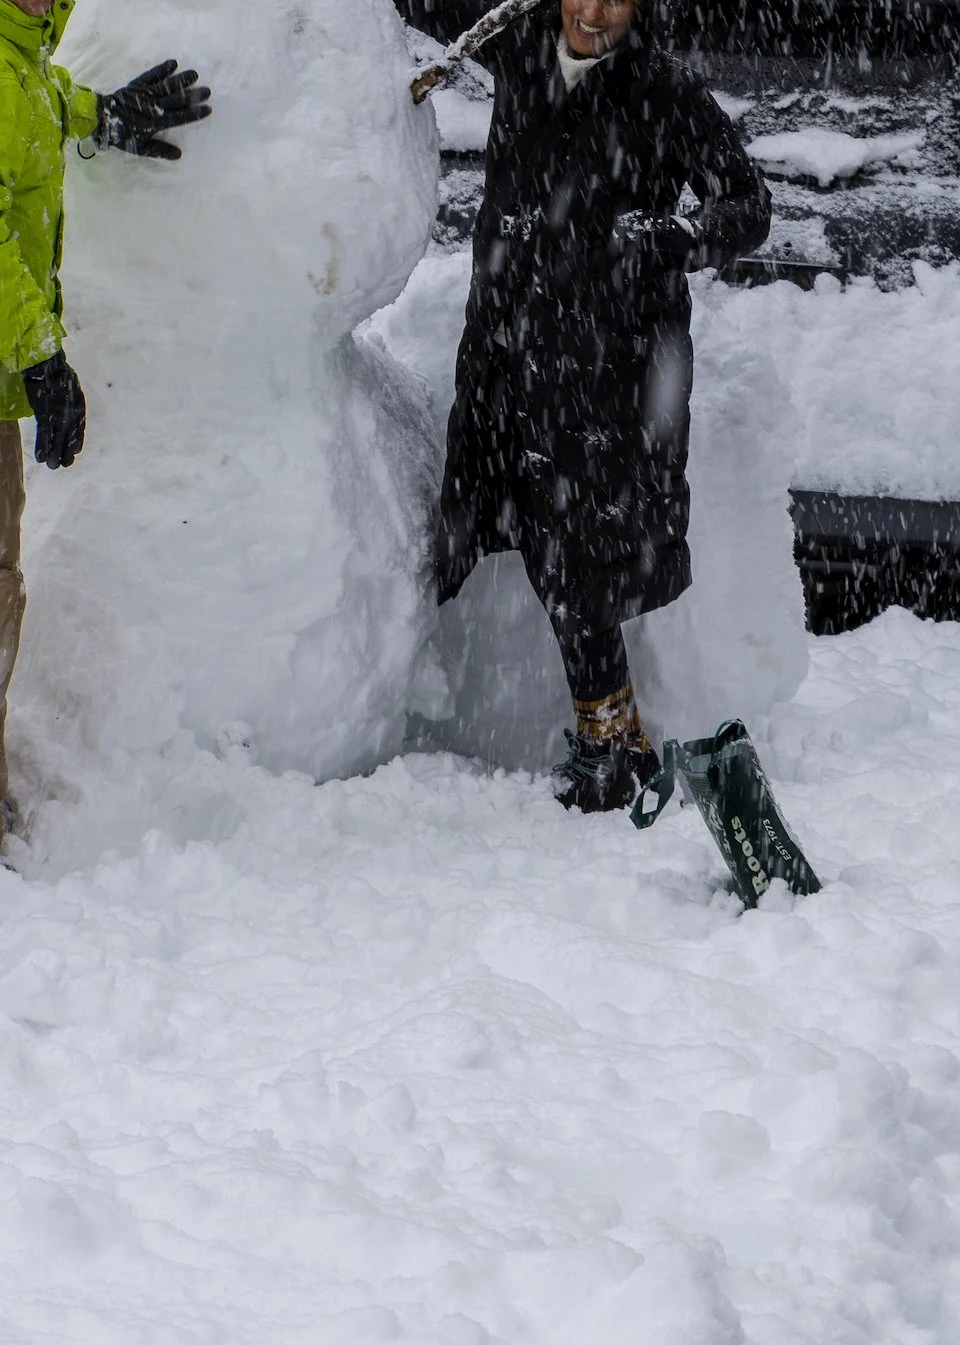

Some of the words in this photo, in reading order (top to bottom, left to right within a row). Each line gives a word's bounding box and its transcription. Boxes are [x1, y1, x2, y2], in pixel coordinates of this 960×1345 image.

[763, 818, 778, 842] 1973
[731, 816, 770, 895] Roots
[775, 842, 792, 861] EST.
